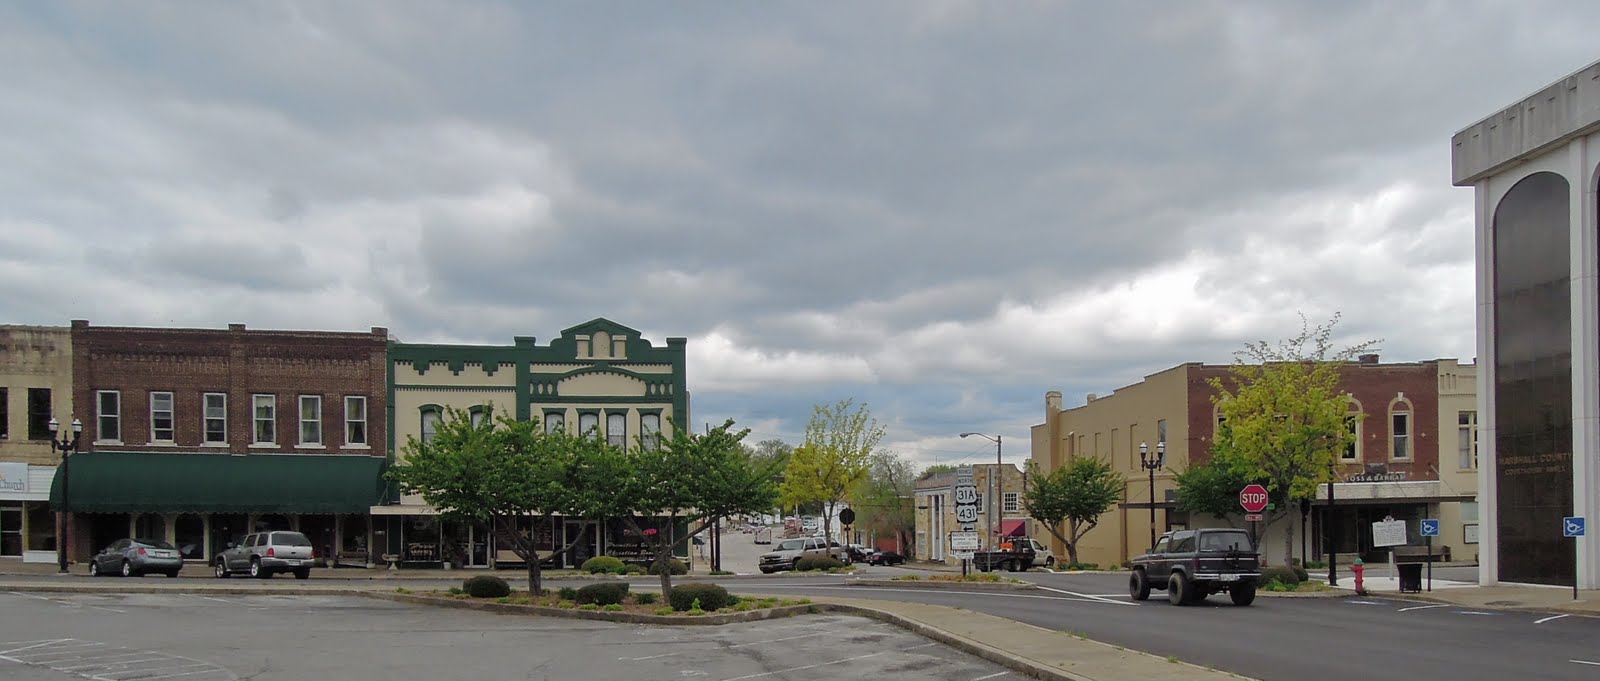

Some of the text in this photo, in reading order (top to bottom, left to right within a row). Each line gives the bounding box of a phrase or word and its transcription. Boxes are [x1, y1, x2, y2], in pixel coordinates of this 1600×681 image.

[958, 490, 975, 500] 31A
[1242, 493, 1266, 504] STOP
[959, 508, 976, 519] 431
